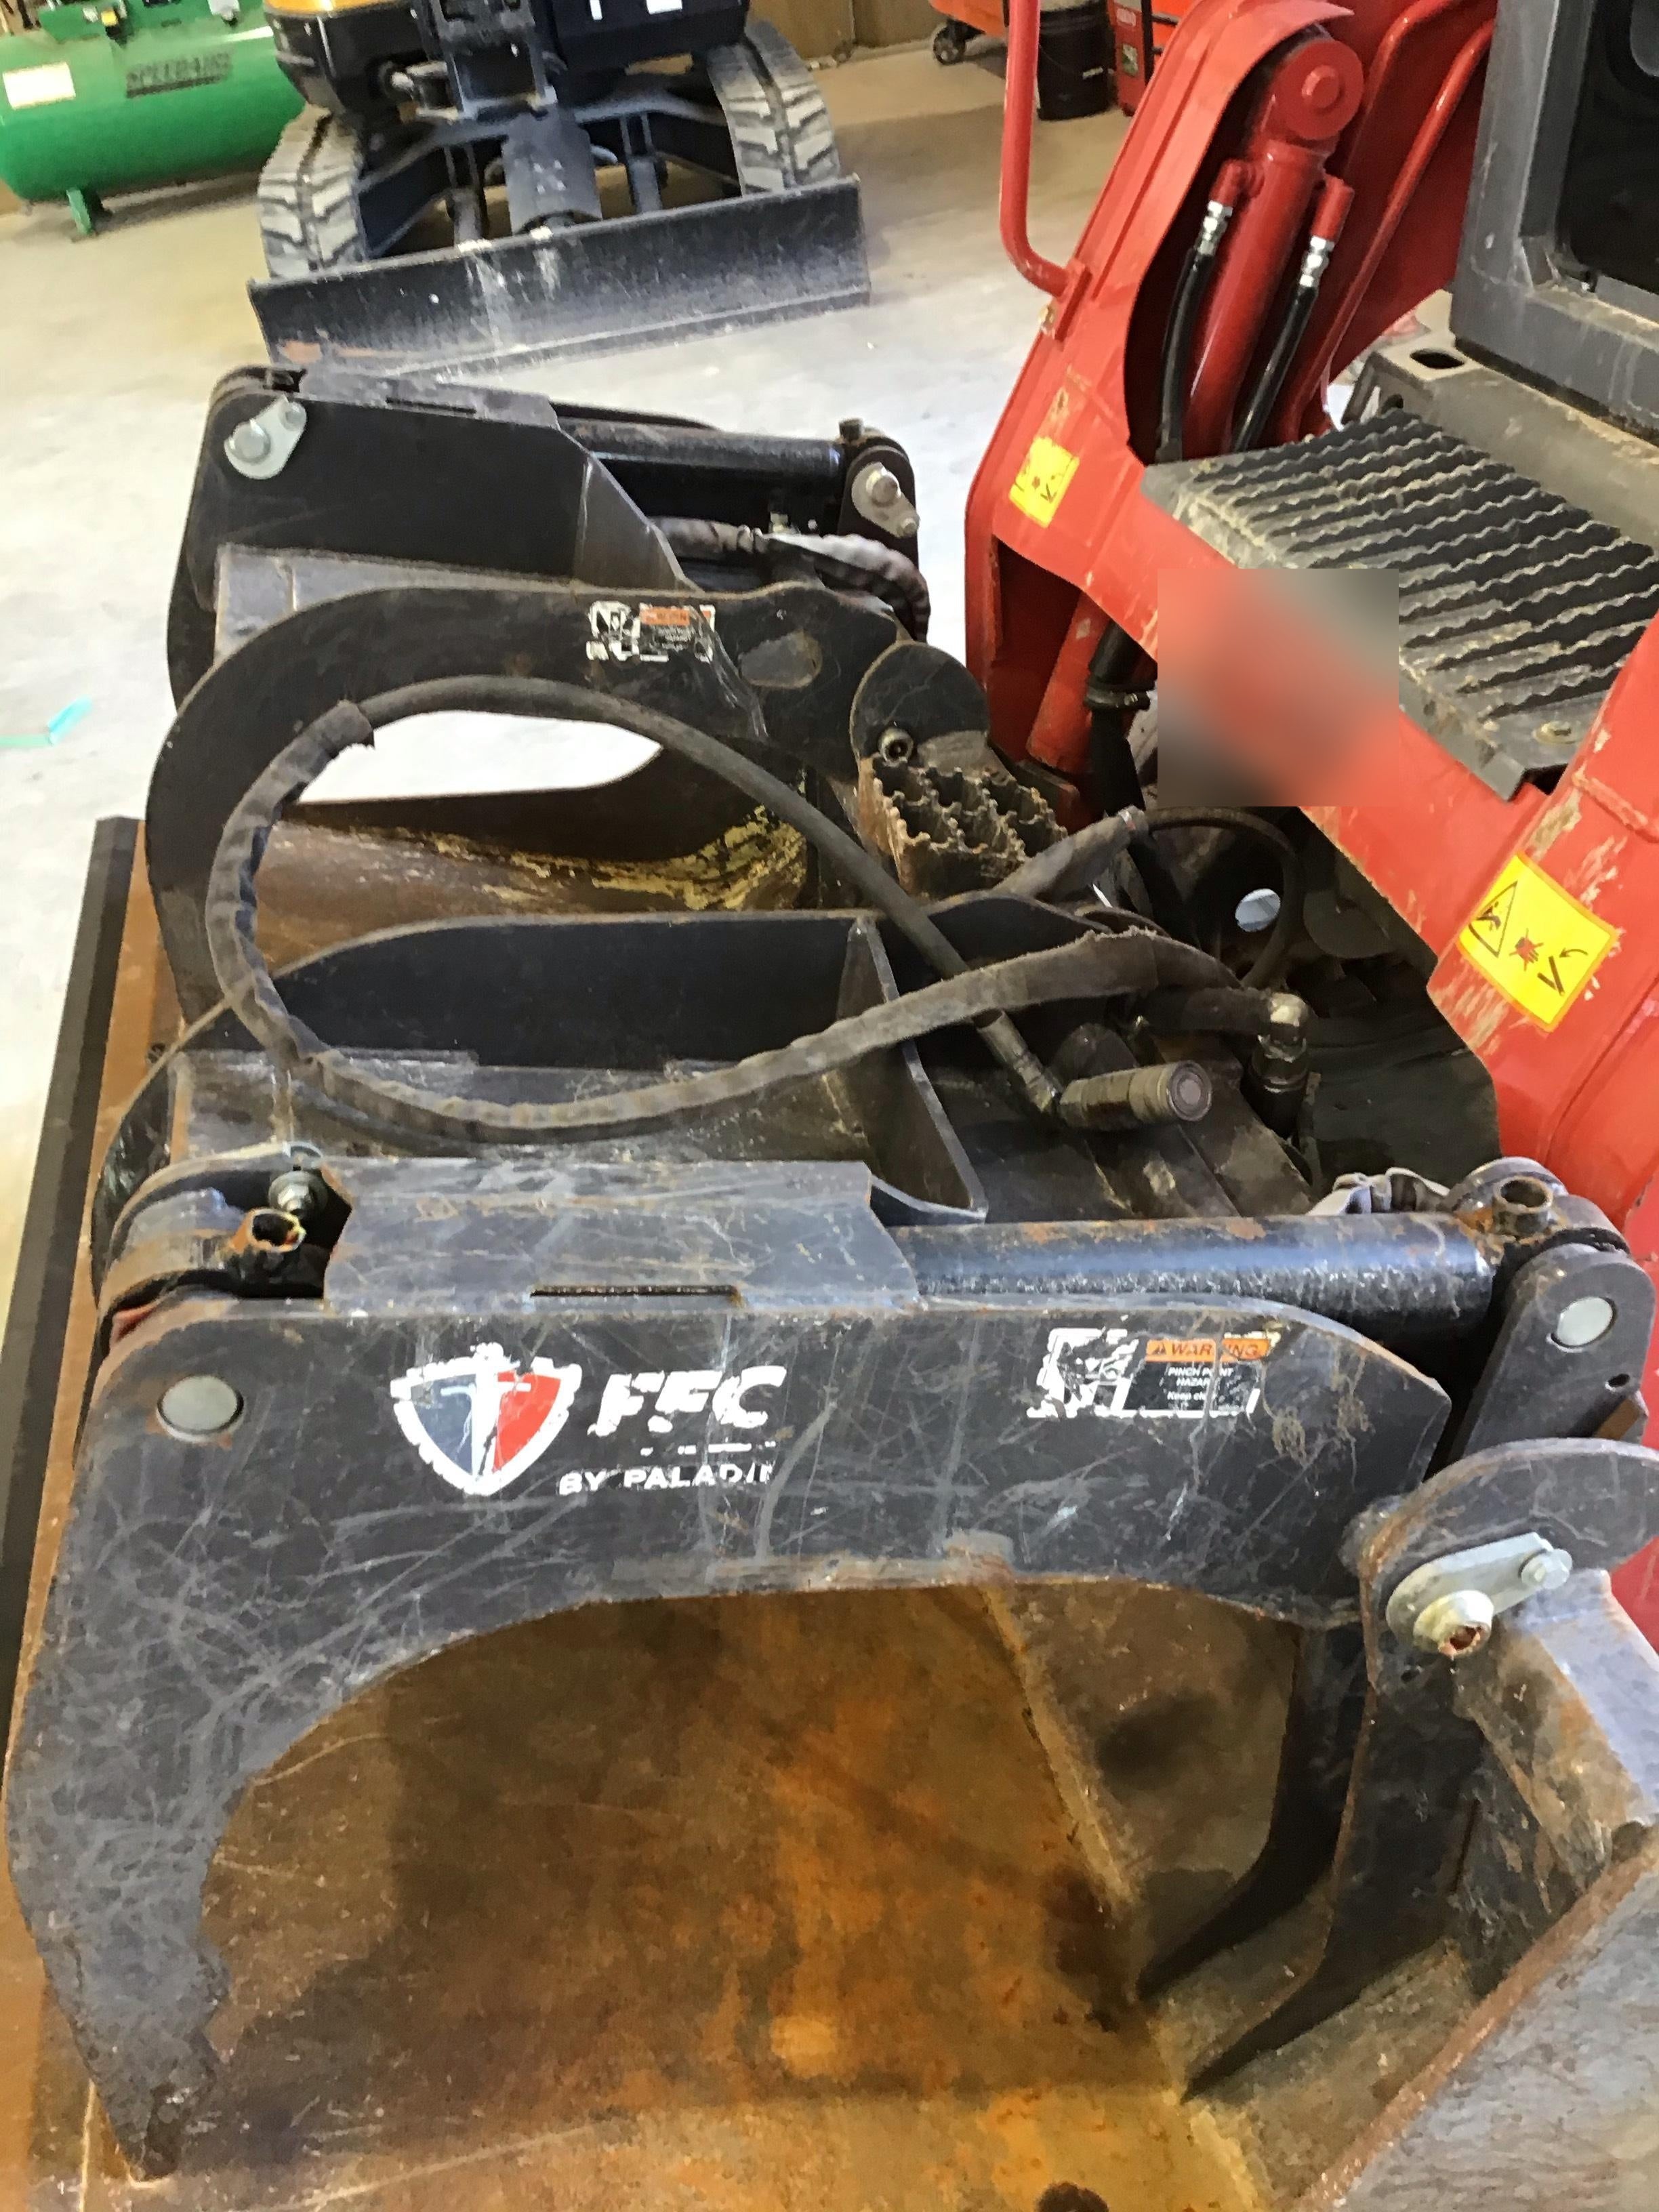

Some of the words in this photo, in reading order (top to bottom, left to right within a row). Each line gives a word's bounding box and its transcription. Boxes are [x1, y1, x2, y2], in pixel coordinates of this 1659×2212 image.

[1172, 1343, 1258, 1356] WARING
[1168, 1366, 1200, 1376] PINCH
[1176, 1377, 1210, 1387] HAZAR
[588, 1366, 787, 1436] FFC
[559, 1471, 607, 1495] BY
